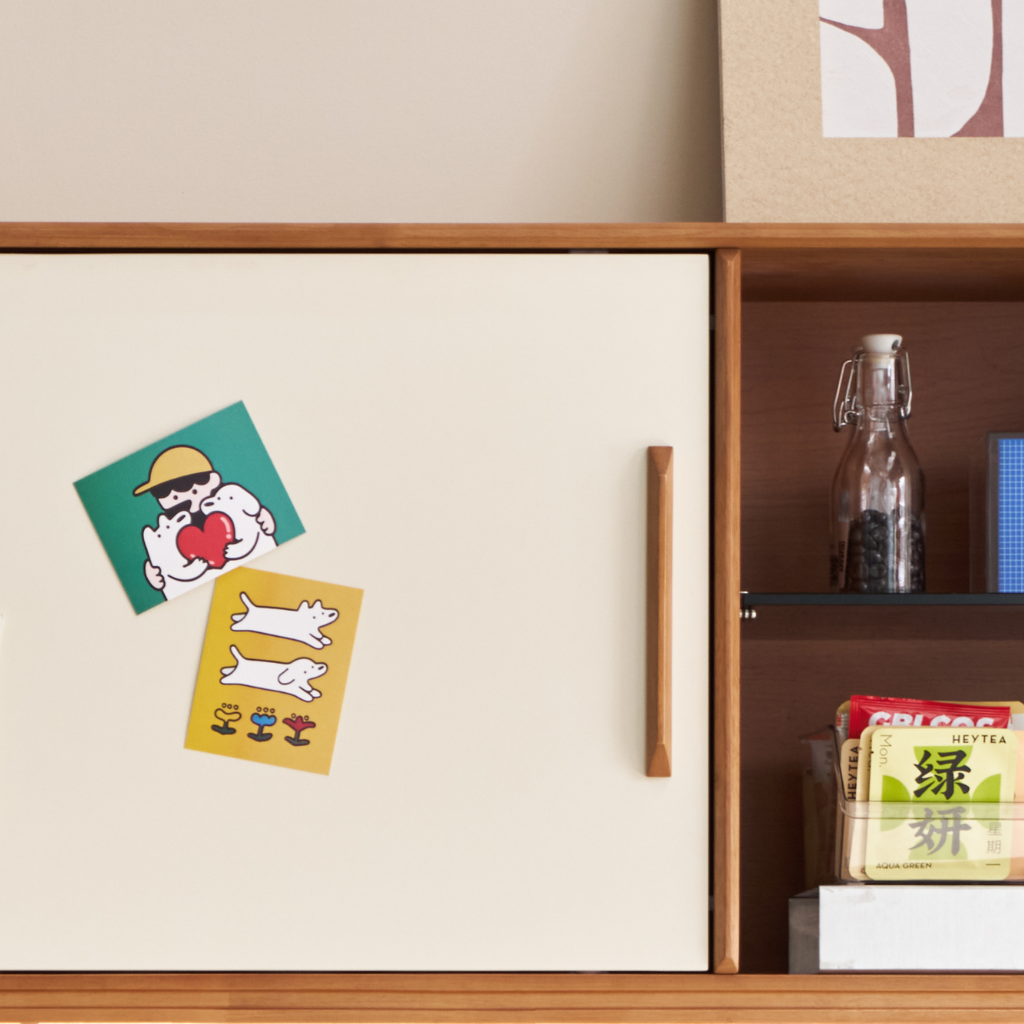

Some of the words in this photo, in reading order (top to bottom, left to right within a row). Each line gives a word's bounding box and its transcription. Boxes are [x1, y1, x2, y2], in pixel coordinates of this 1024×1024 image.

[952, 734, 1007, 744] HEYTEA
[847, 745, 859, 801] HEYTEA
[876, 862, 900, 870] AQUA
